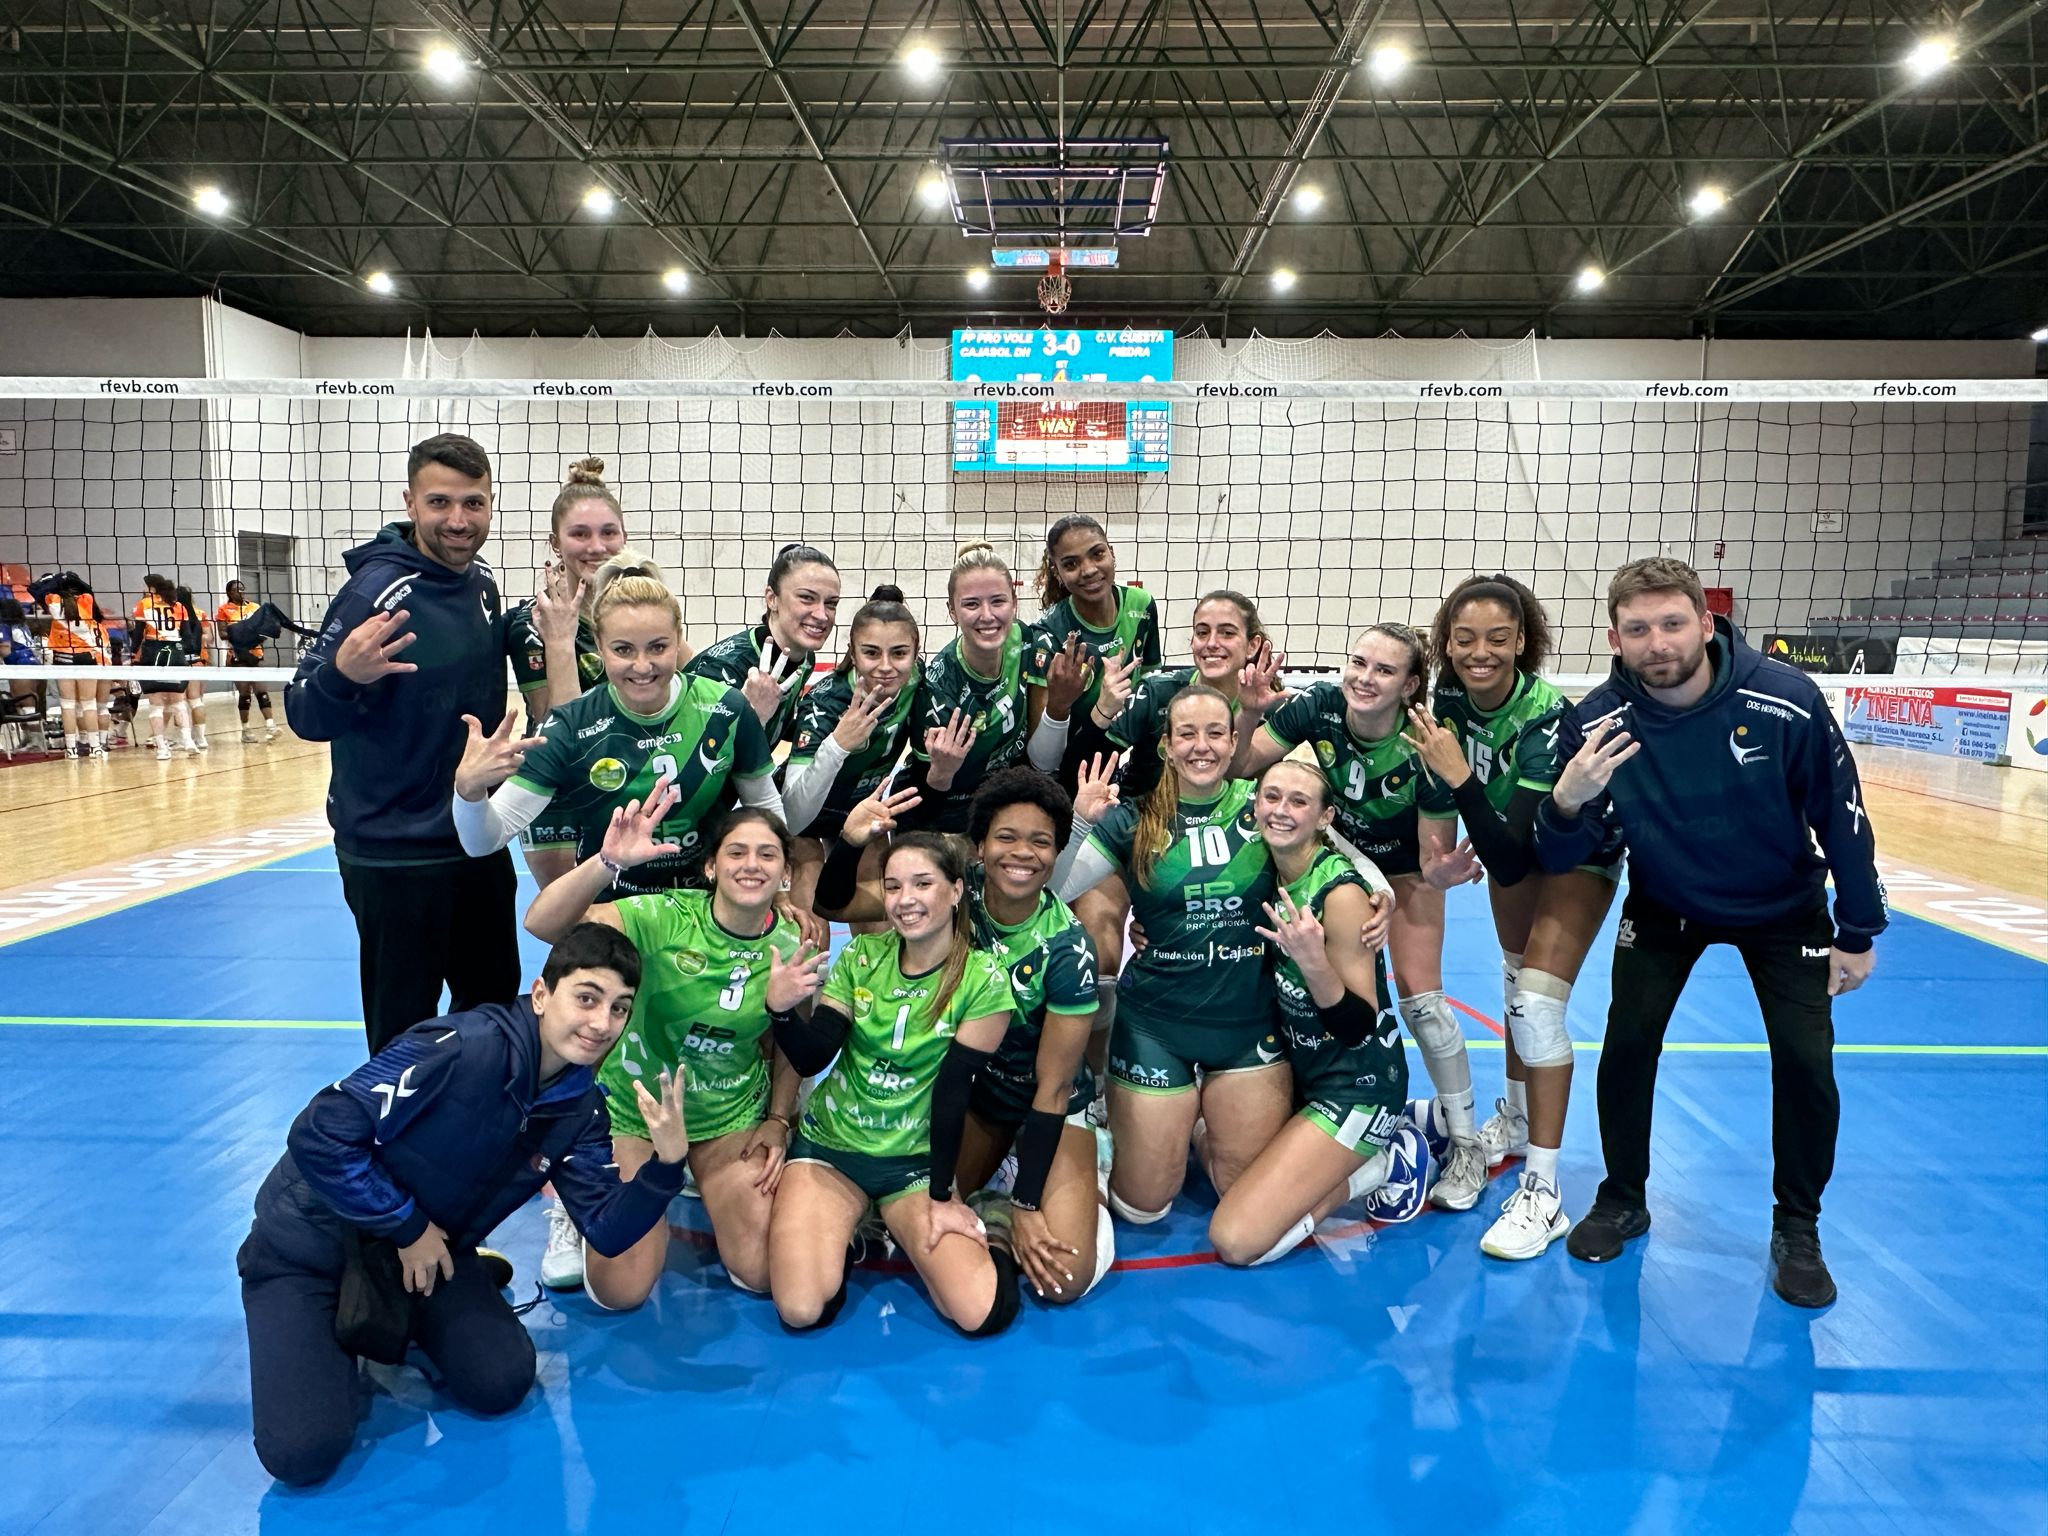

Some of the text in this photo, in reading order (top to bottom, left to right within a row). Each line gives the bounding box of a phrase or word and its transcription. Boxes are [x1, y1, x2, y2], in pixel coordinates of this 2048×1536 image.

[101, 380, 178, 394] rfevb.com
[316, 381, 394, 395] rfevb.com
[534, 382, 612, 396] rfevb.com
[753, 383, 832, 396] rfevb.com
[974, 383, 1054, 396] rfevb.com
[1197, 383, 1277, 396] rfevb.com
[1421, 383, 1502, 396] rfevb.com
[1646, 383, 1728, 396] rfevb.com
[1873, 383, 1956, 396] rfevb.com
[1038, 418, 1077, 433] WAY
[154, 607, 176, 631] 16
[1746, 700, 1761, 711] DOS
[1866, 694, 1934, 727] INELNA
[1466, 734, 1493, 785] 15
[652, 754, 682, 804] 2
[1344, 760, 1366, 800] 9
[1185, 825, 1231, 868] 10
[1184, 881, 1236, 900] FP
[1185, 896, 1243, 913] PRO
[1153, 942, 1265, 963] Fundación Cajasol
[719, 966, 752, 1012] 3
[891, 1004, 912, 1050] 1
[684, 1034, 735, 1055] PRO
[1112, 1055, 1169, 1080] MAX
[868, 1070, 917, 1092] PRO
